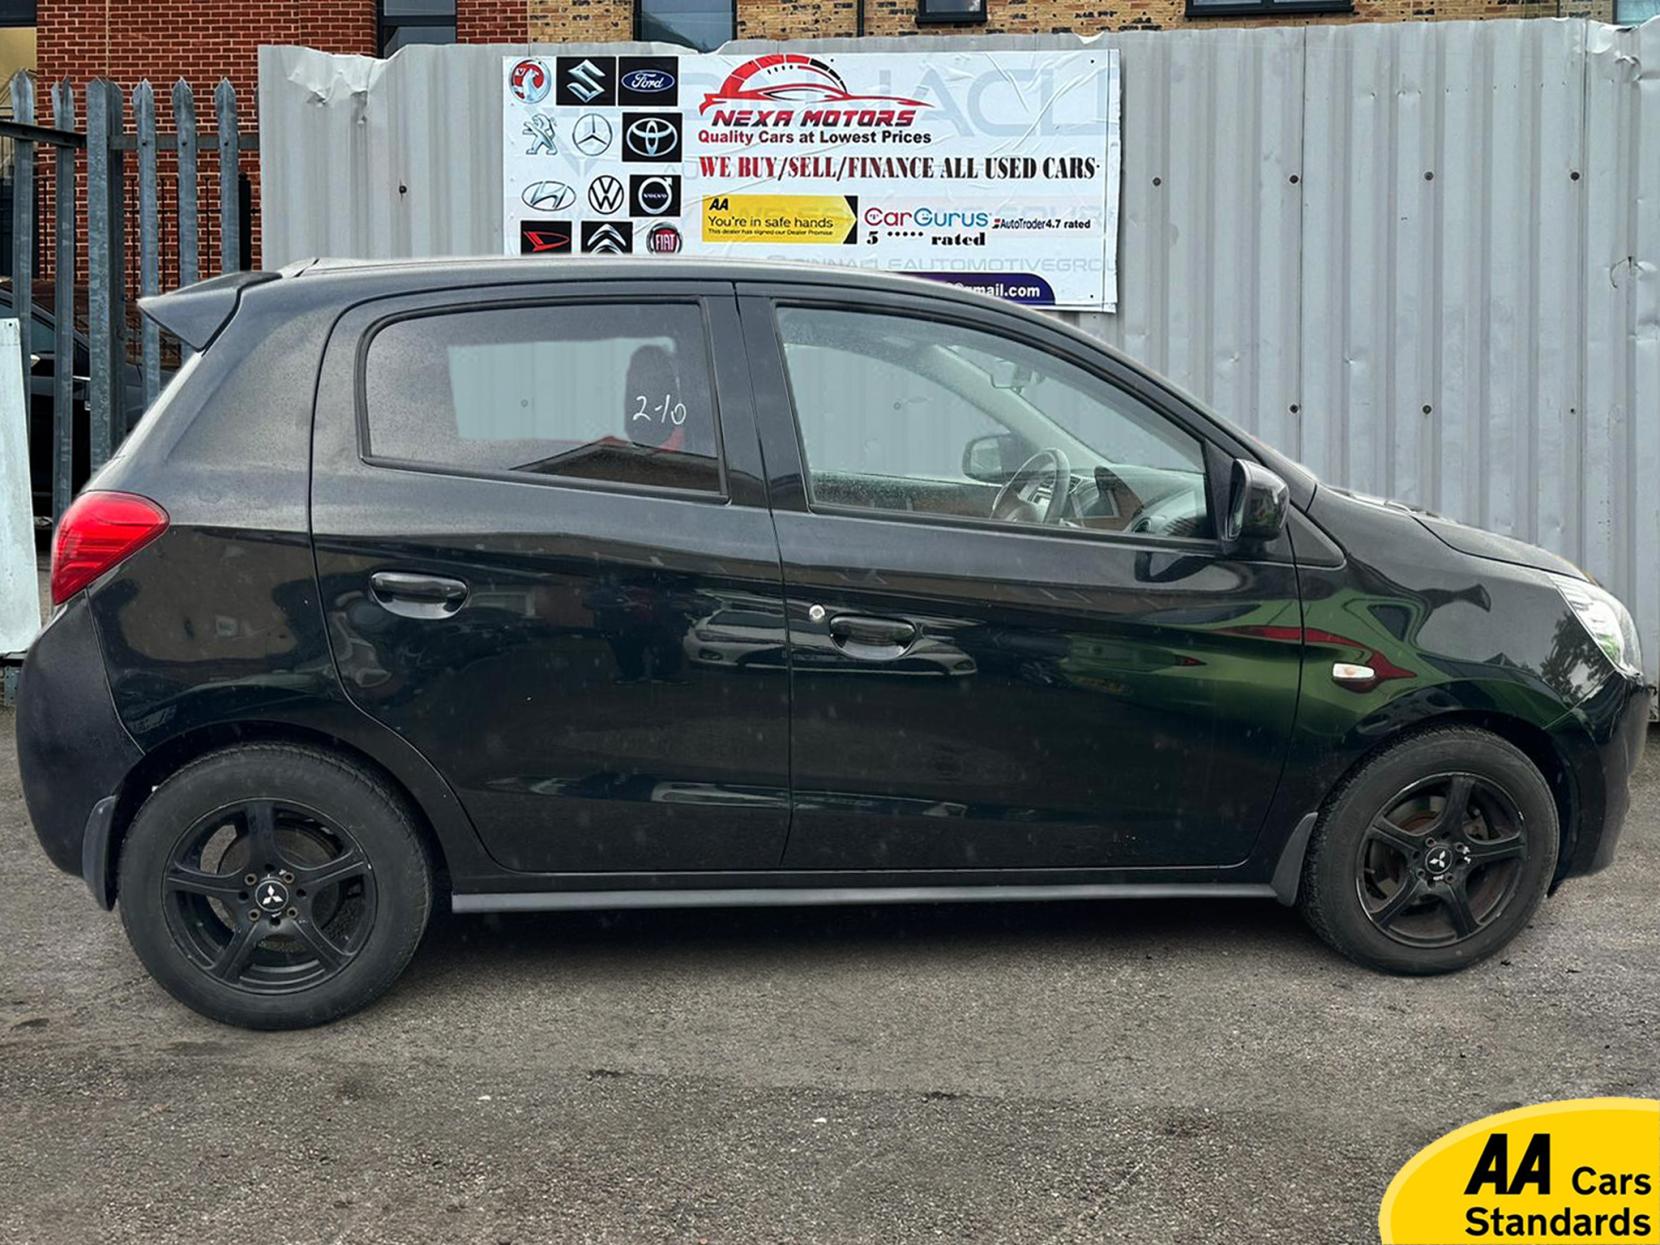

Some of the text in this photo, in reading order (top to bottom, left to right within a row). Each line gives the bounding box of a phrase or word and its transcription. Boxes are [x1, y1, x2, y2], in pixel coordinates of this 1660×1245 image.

[631, 73, 664, 88] Ford
[711, 110, 916, 127] NEXA MOTORS
[698, 130, 932, 145] Quality Cars at Lowest Prices
[699, 156, 731, 178] WE
[940, 157, 979, 179] ALL
[985, 157, 1037, 179] USED
[709, 198, 729, 211] AA
[708, 216, 834, 228] You're in safe hands
[864, 207, 989, 227] CarGurus
[1064, 219, 1091, 229] rated
[655, 233, 676, 251] FIAT
[866, 231, 986, 246] 5 rated
